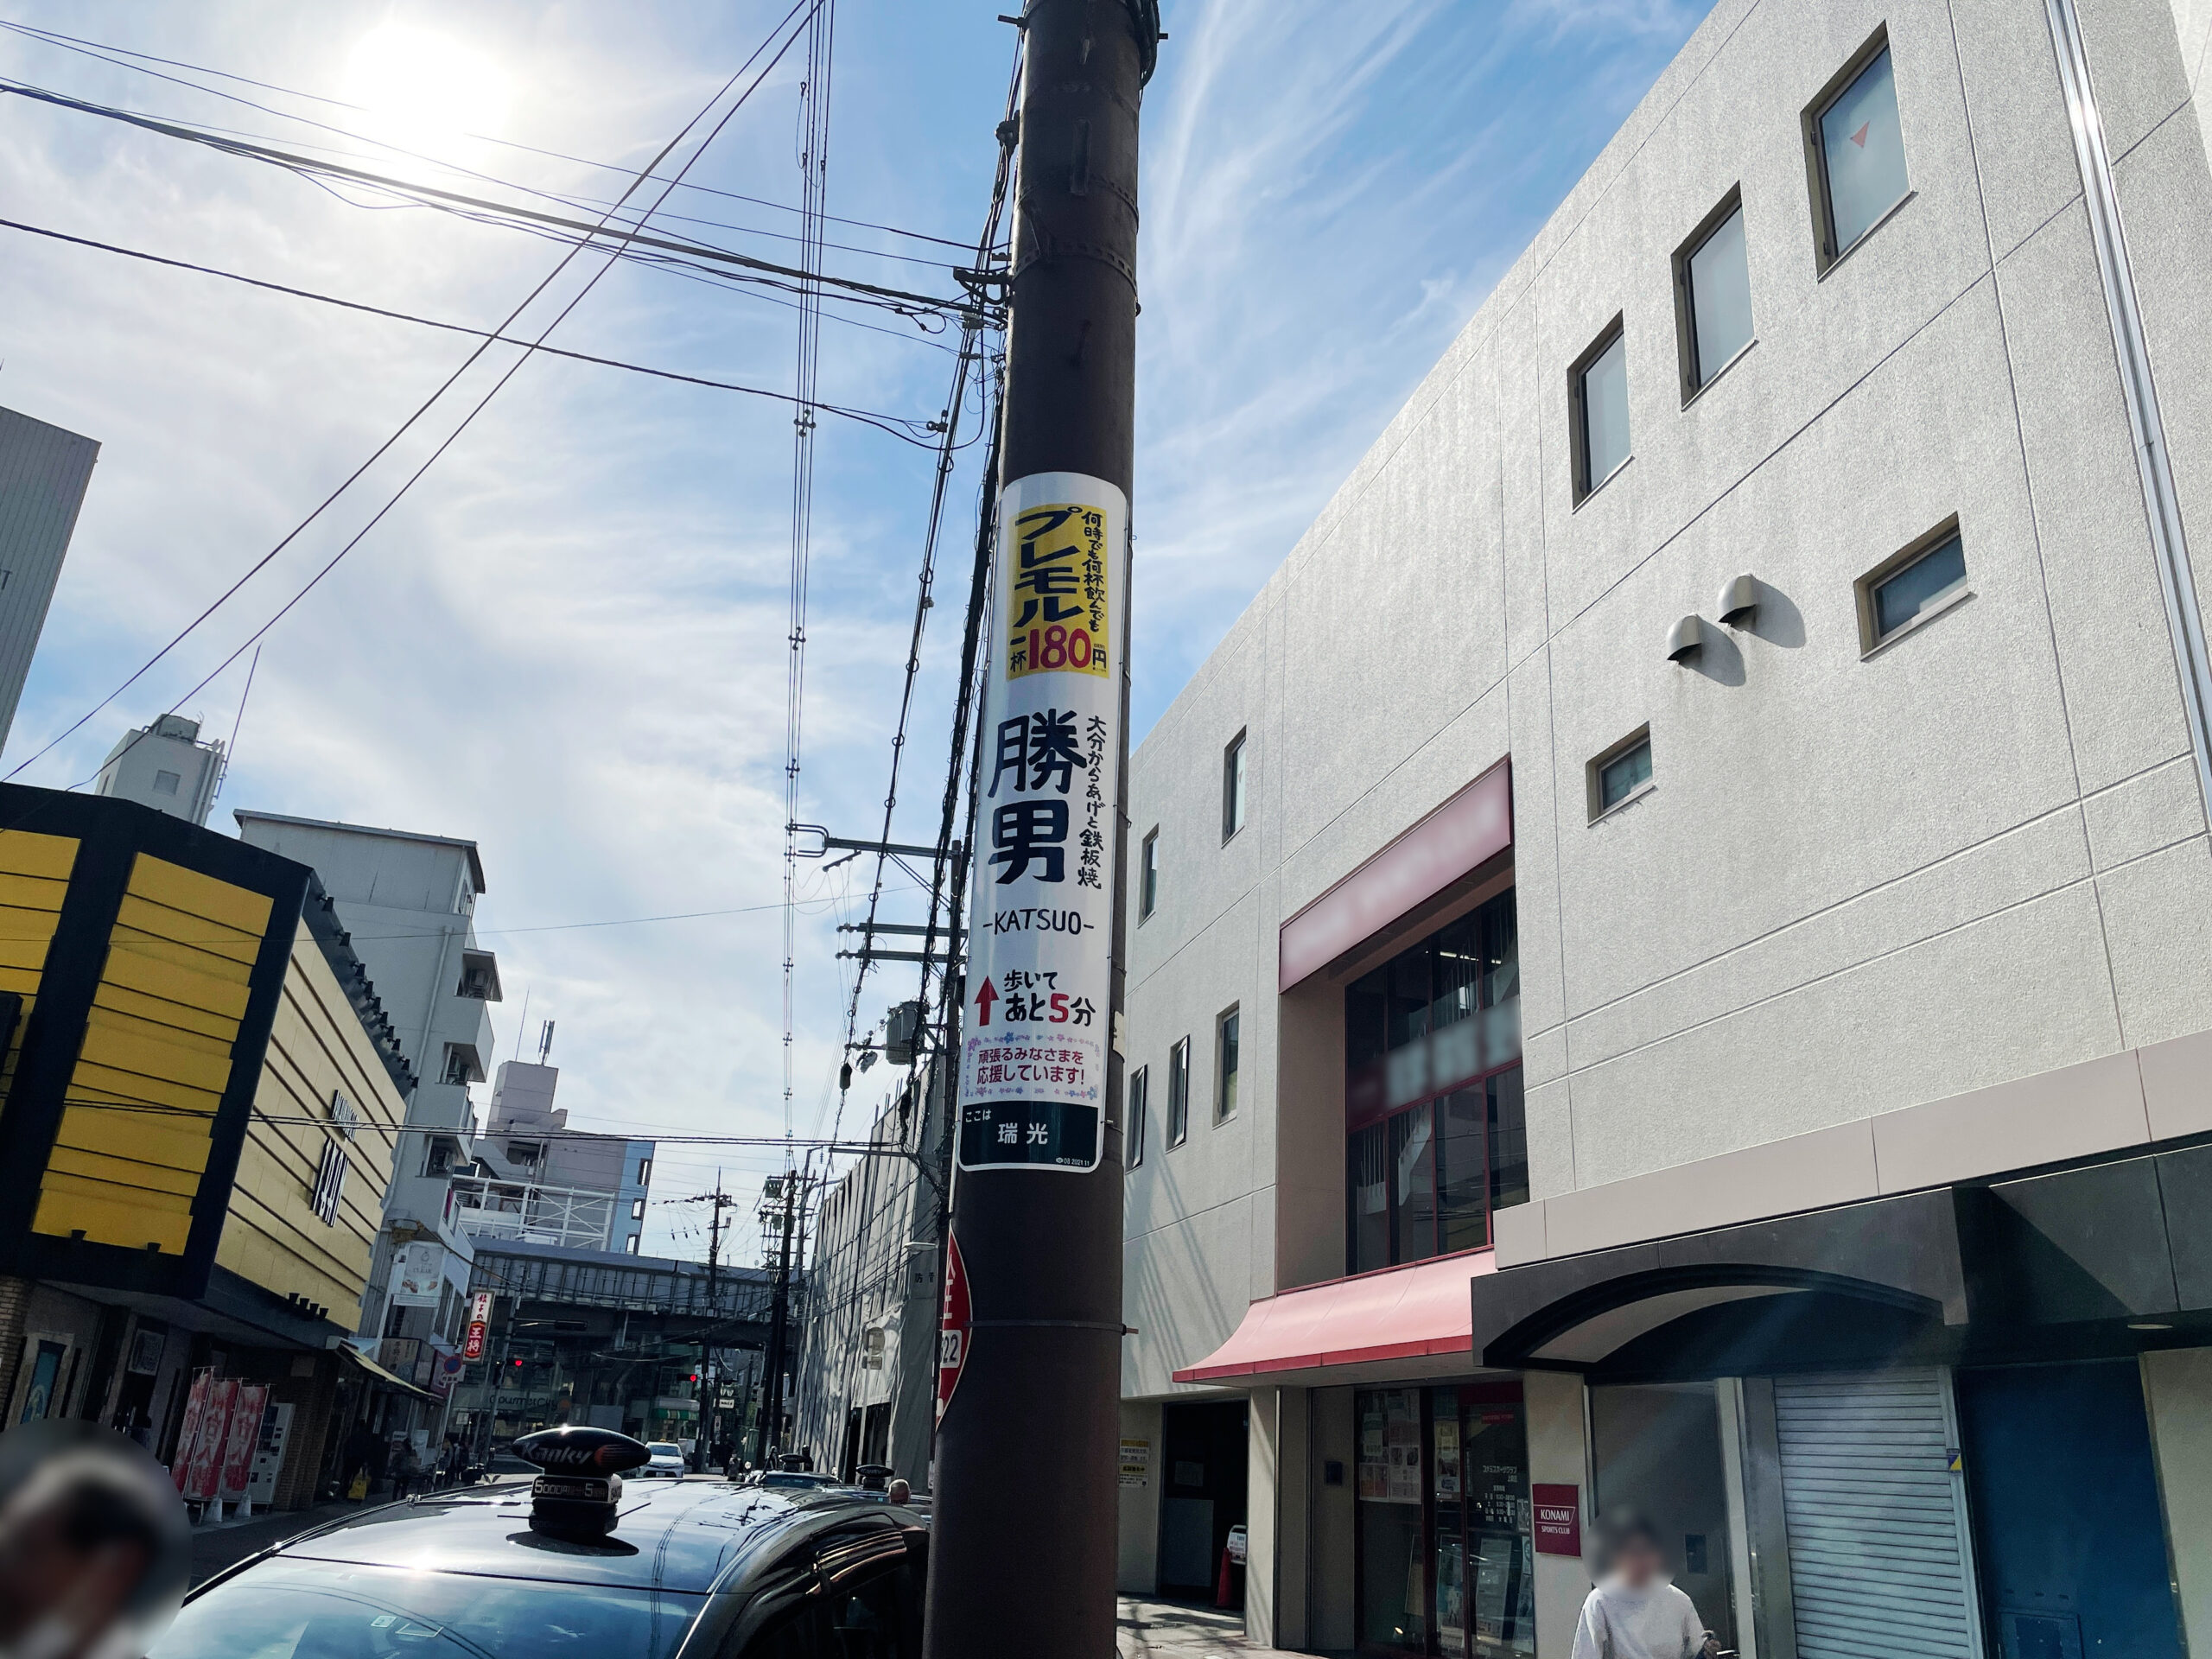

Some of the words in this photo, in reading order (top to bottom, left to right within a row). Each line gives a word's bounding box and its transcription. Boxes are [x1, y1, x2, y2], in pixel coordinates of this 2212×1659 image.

[1013, 506, 1084, 628] プレモル
[1081, 512, 1106, 632] 何時でも何杯飲んでも
[987, 708, 1088, 886] 勝男
[1077, 715, 1107, 890] 大分からあげと鉄板焼
[1003, 969, 1058, 993] 歩いて
[1004, 993, 1096, 1027] あと5分
[978, 1047, 1084, 1065] 頑張るみなさまを
[965, 1109, 992, 1123] ここは
[997, 1122, 1049, 1146] 瑞光
[941, 1333, 959, 1363] 22
[1540, 1509, 1570, 1522] KONAMI
